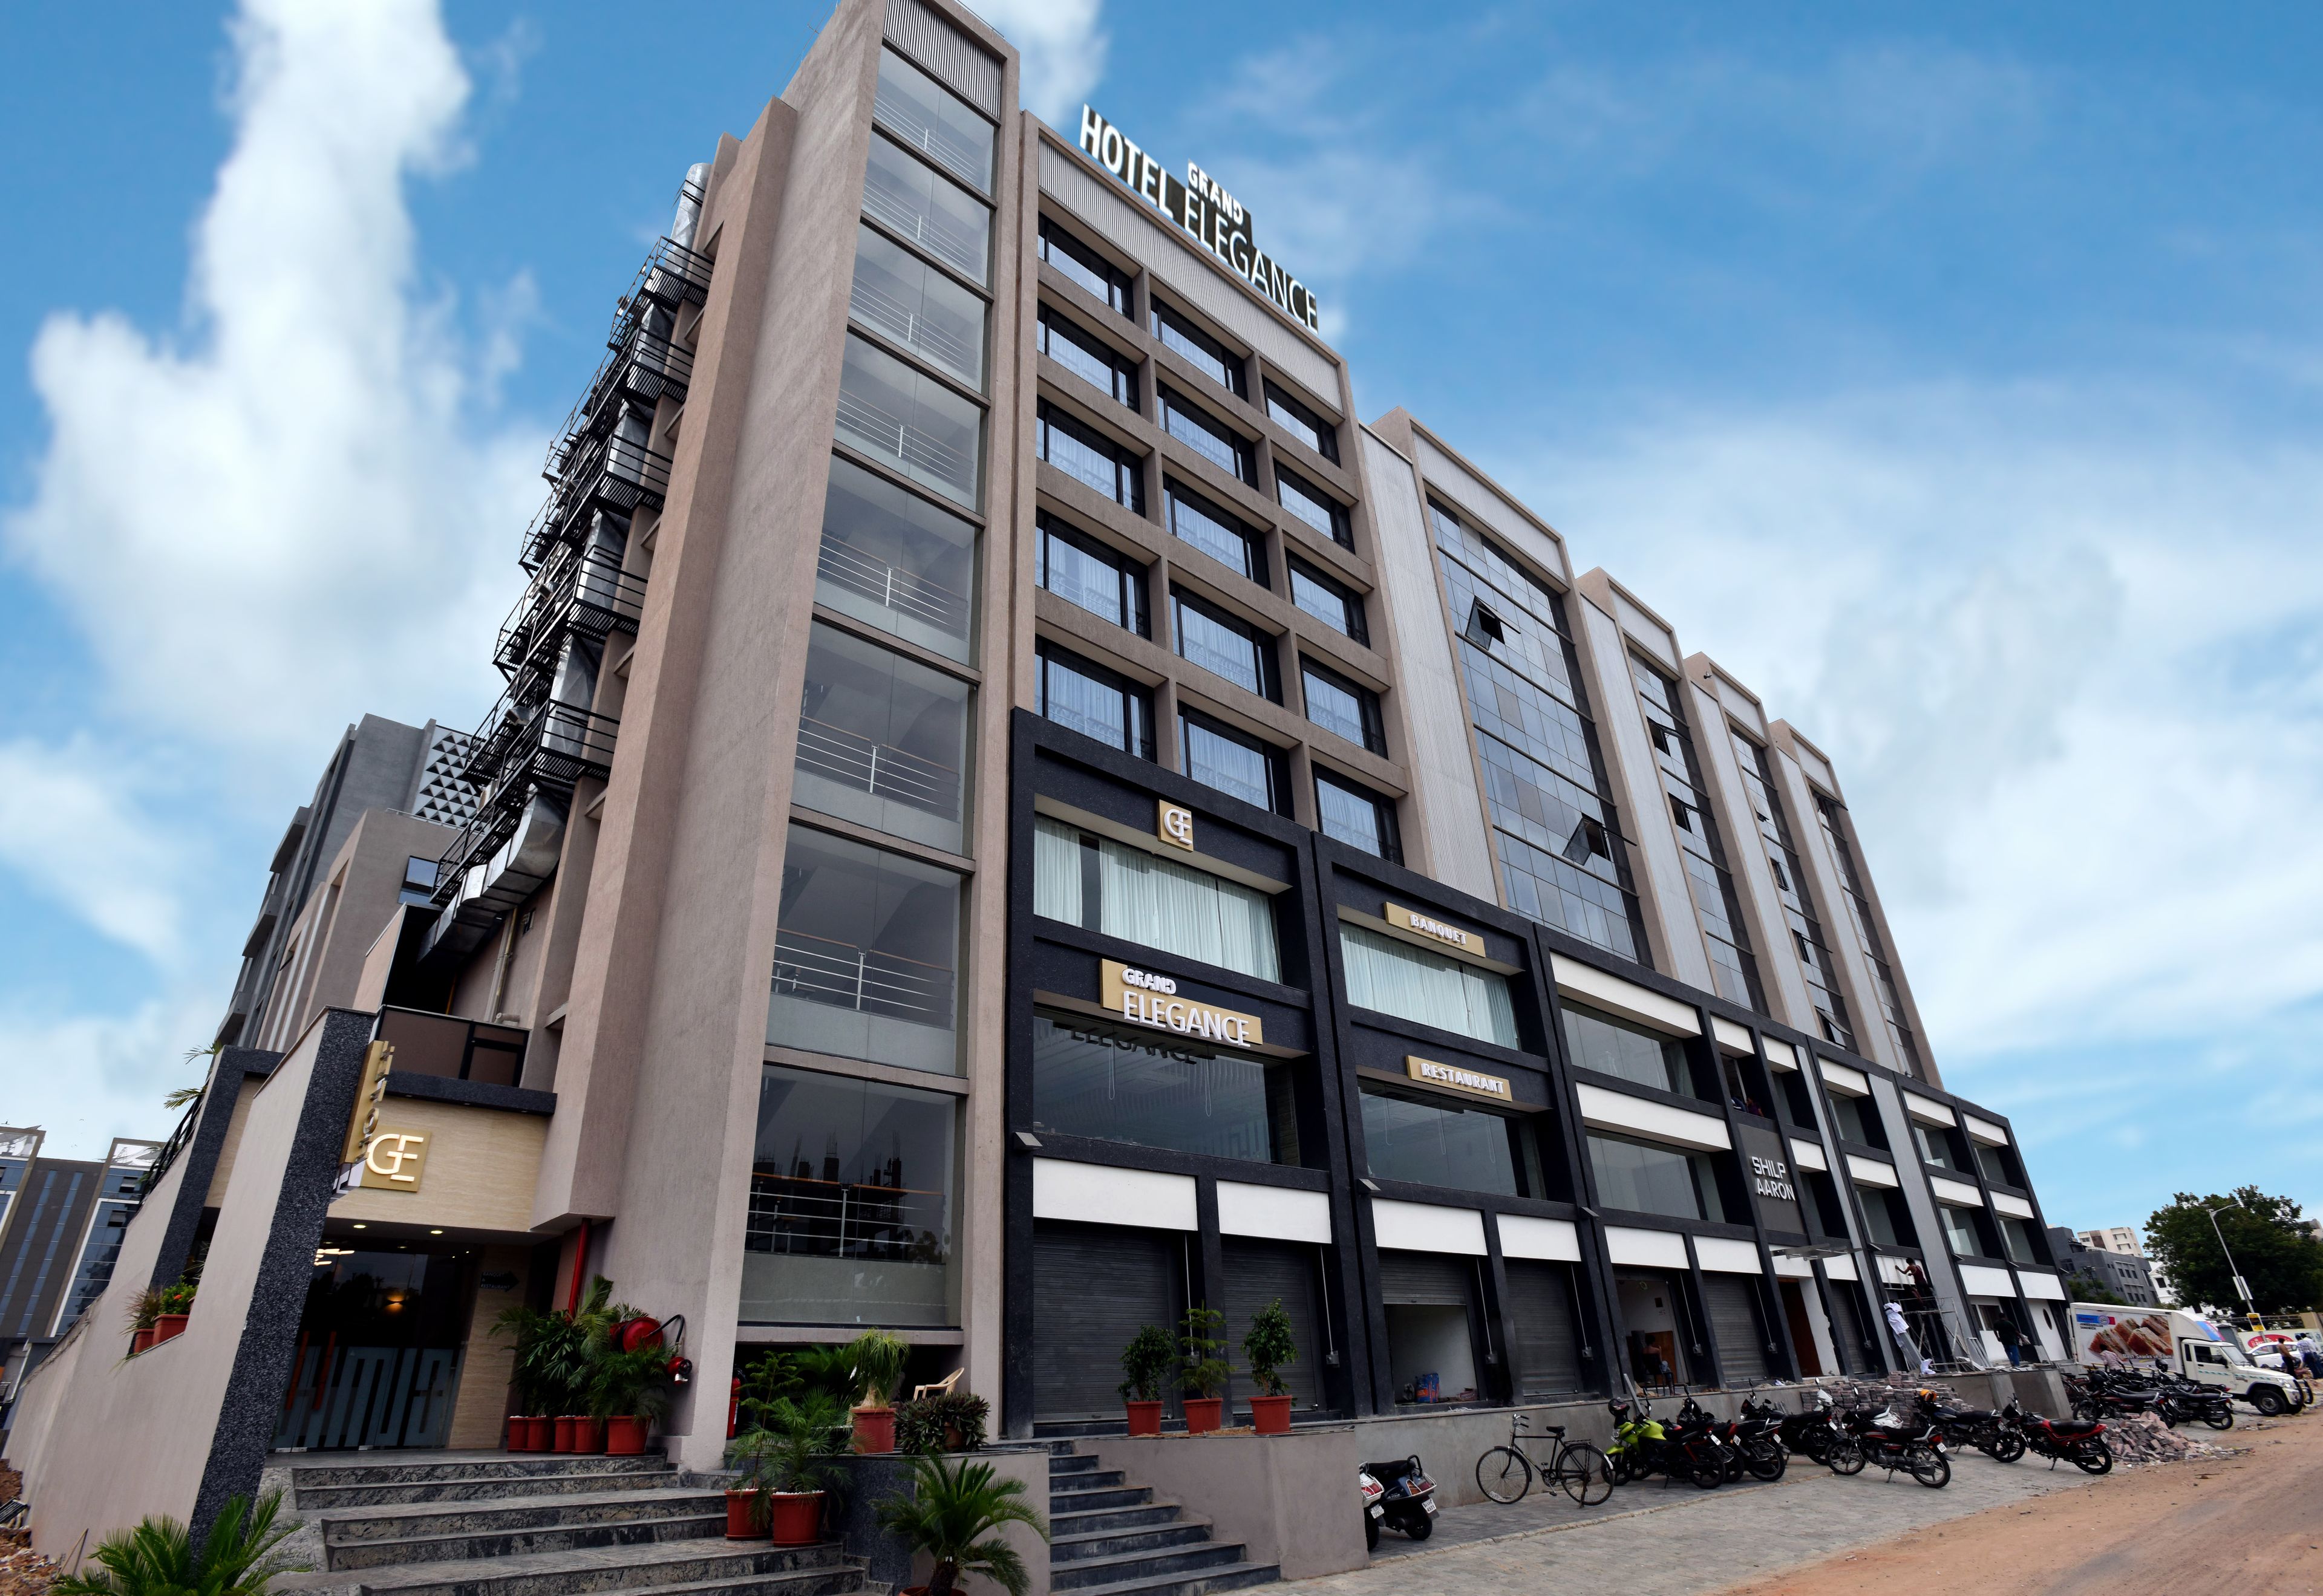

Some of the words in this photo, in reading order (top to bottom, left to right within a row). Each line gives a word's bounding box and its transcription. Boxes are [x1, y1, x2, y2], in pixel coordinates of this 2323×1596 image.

[1188, 160, 1244, 226] GRAND
[1080, 103, 1174, 219] HOTEL
[1184, 187, 1319, 335] ELEGANCE
[1408, 914, 1467, 945] BANQUET
[1122, 968, 1177, 995] GRAND
[1123, 991, 1251, 1047] ELEGANCE
[1420, 1063, 1503, 1094] RESTAURANT
[1751, 1156, 1786, 1179] SHILP
[1756, 1178, 1795, 1201] AARON
